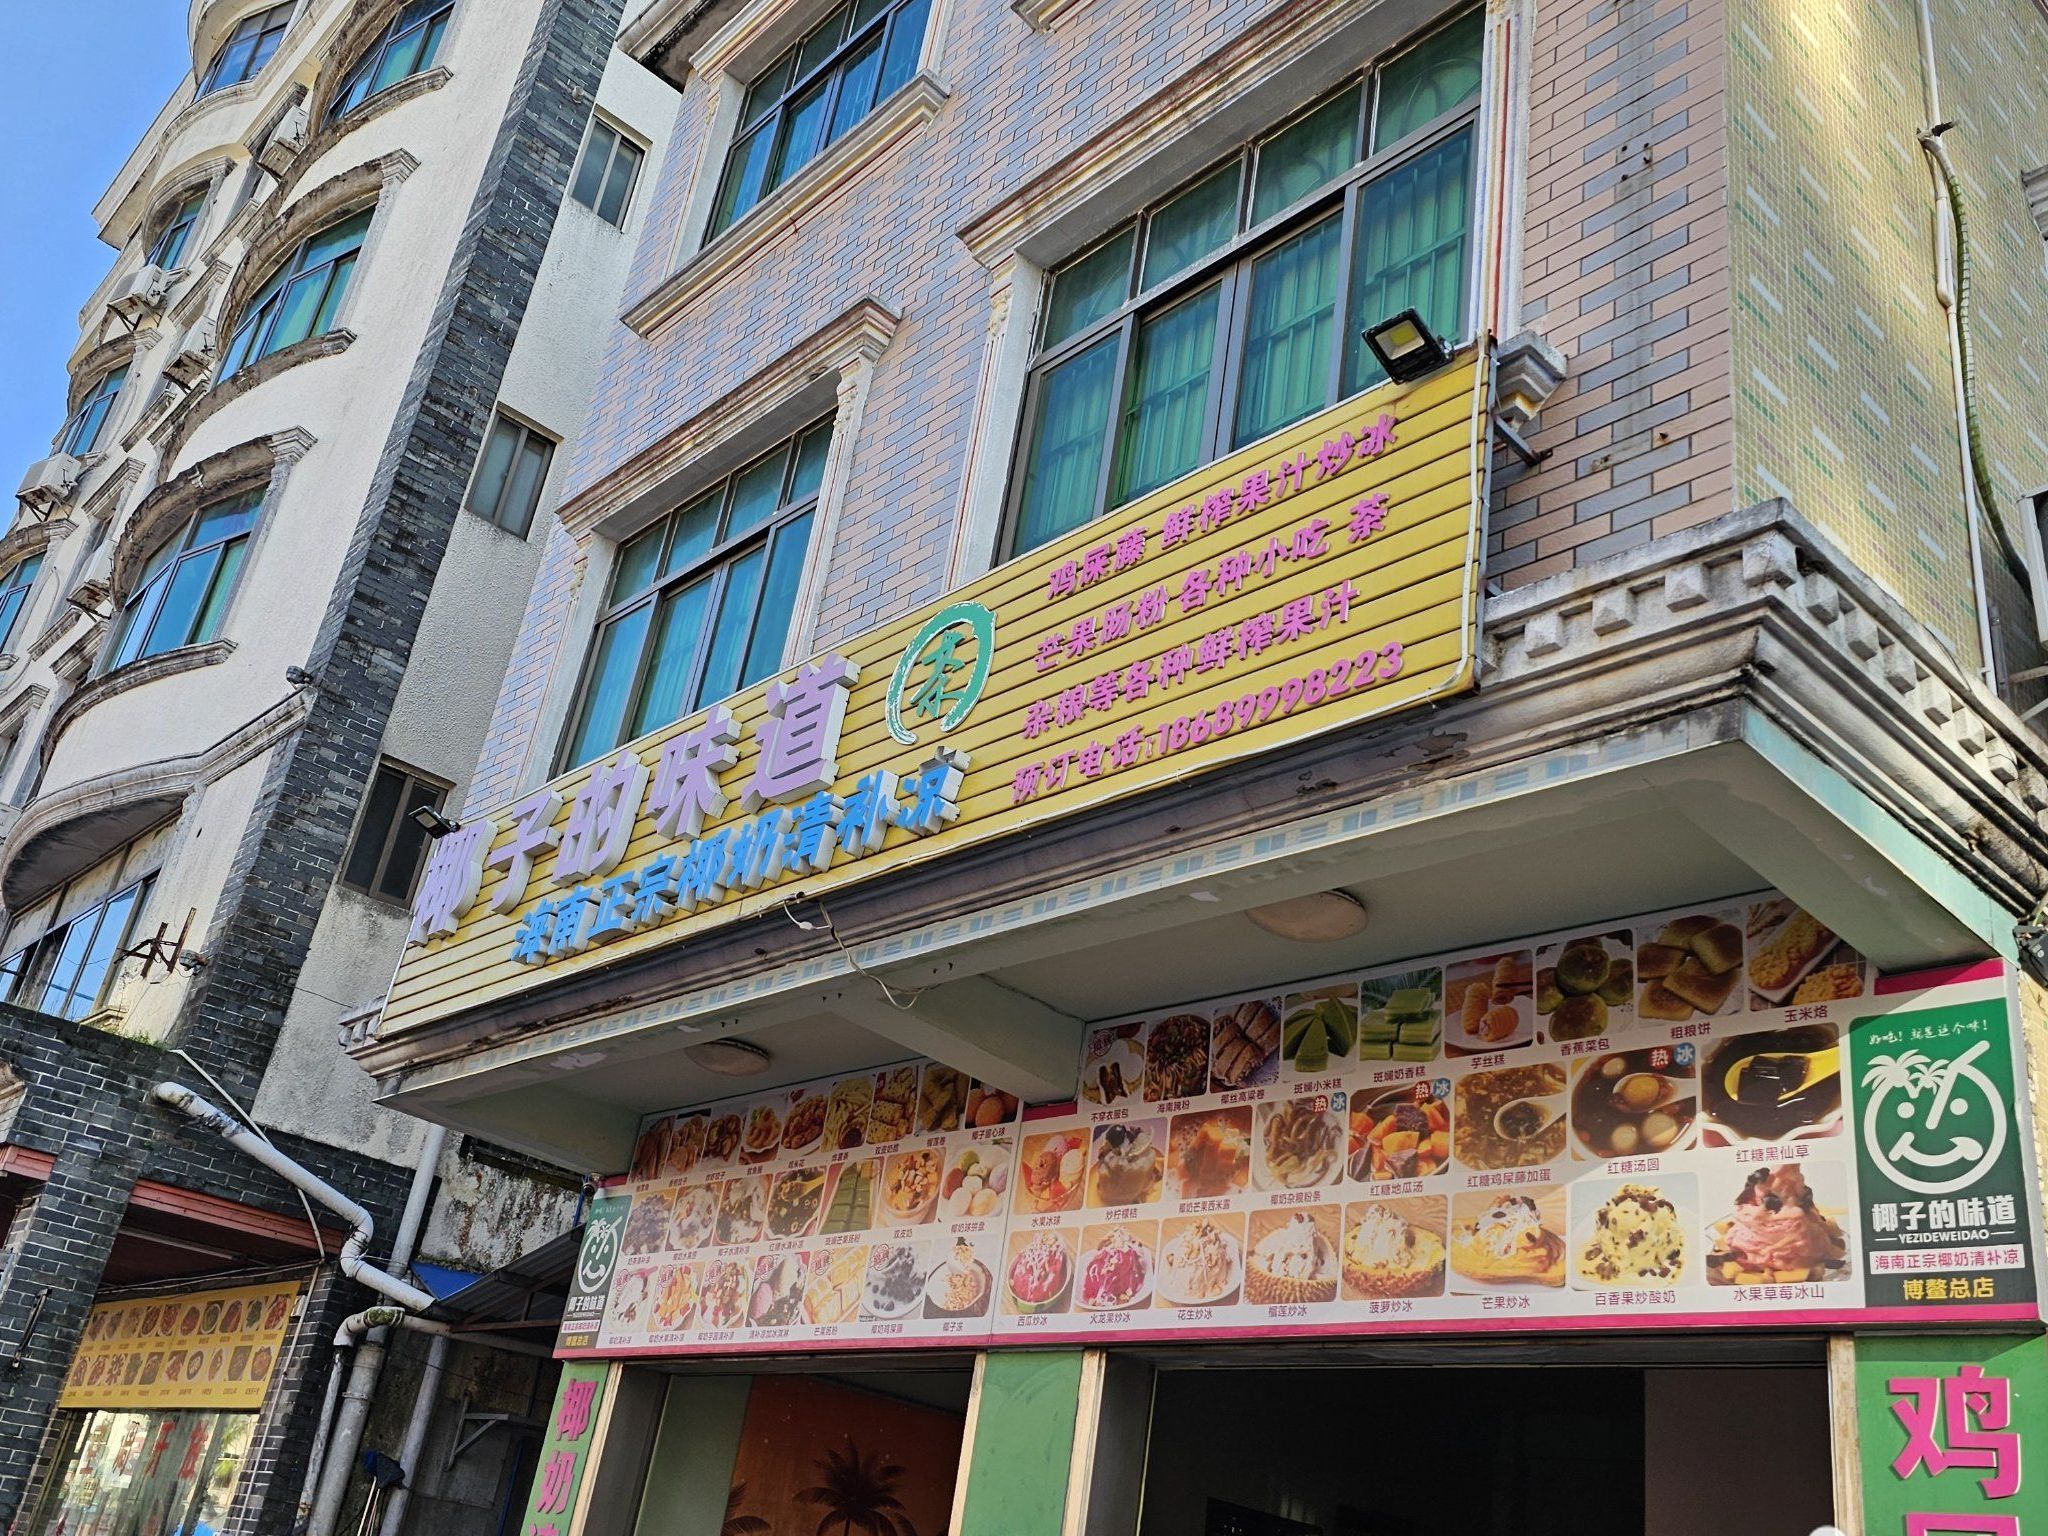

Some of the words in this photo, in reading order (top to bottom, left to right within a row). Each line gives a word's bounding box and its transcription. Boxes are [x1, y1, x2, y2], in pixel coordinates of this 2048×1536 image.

[1046, 525, 1148, 600] 鸡屎藤
[1161, 413, 1398, 548] 鲜榨果汁炒冰
[408, 652, 861, 946] 椰子的味道
[511, 747, 972, 967] 海南正宗椰奶清补凉
[1784, 1005, 1829, 1023] 玉米烙
[1736, 1145, 1809, 1164] 红糖黑仙草
[1607, 1158, 1660, 1175] 红糖汤圆
[1871, 1195, 2017, 1232] 椰子的味道
[1899, 1229, 1989, 1244] YEZIDEWEIDAO
[1875, 1247, 2019, 1271] 海南正宗椰奶清补凉
[1732, 1285, 1825, 1302] 水果草莓冰山
[1902, 1277, 1995, 1301] 博鳌总店
[1369, 1301, 1413, 1314] 菠萝炒冰
[1482, 1296, 1530, 1310] 芒果炒冰
[1595, 1292, 1676, 1307] 百香果炒酸奶
[1017, 1315, 1047, 1326] 西瓜炒冰
[1089, 1312, 1131, 1324] 火龙果炒冰
[1177, 1308, 1212, 1320] 花生炒冰
